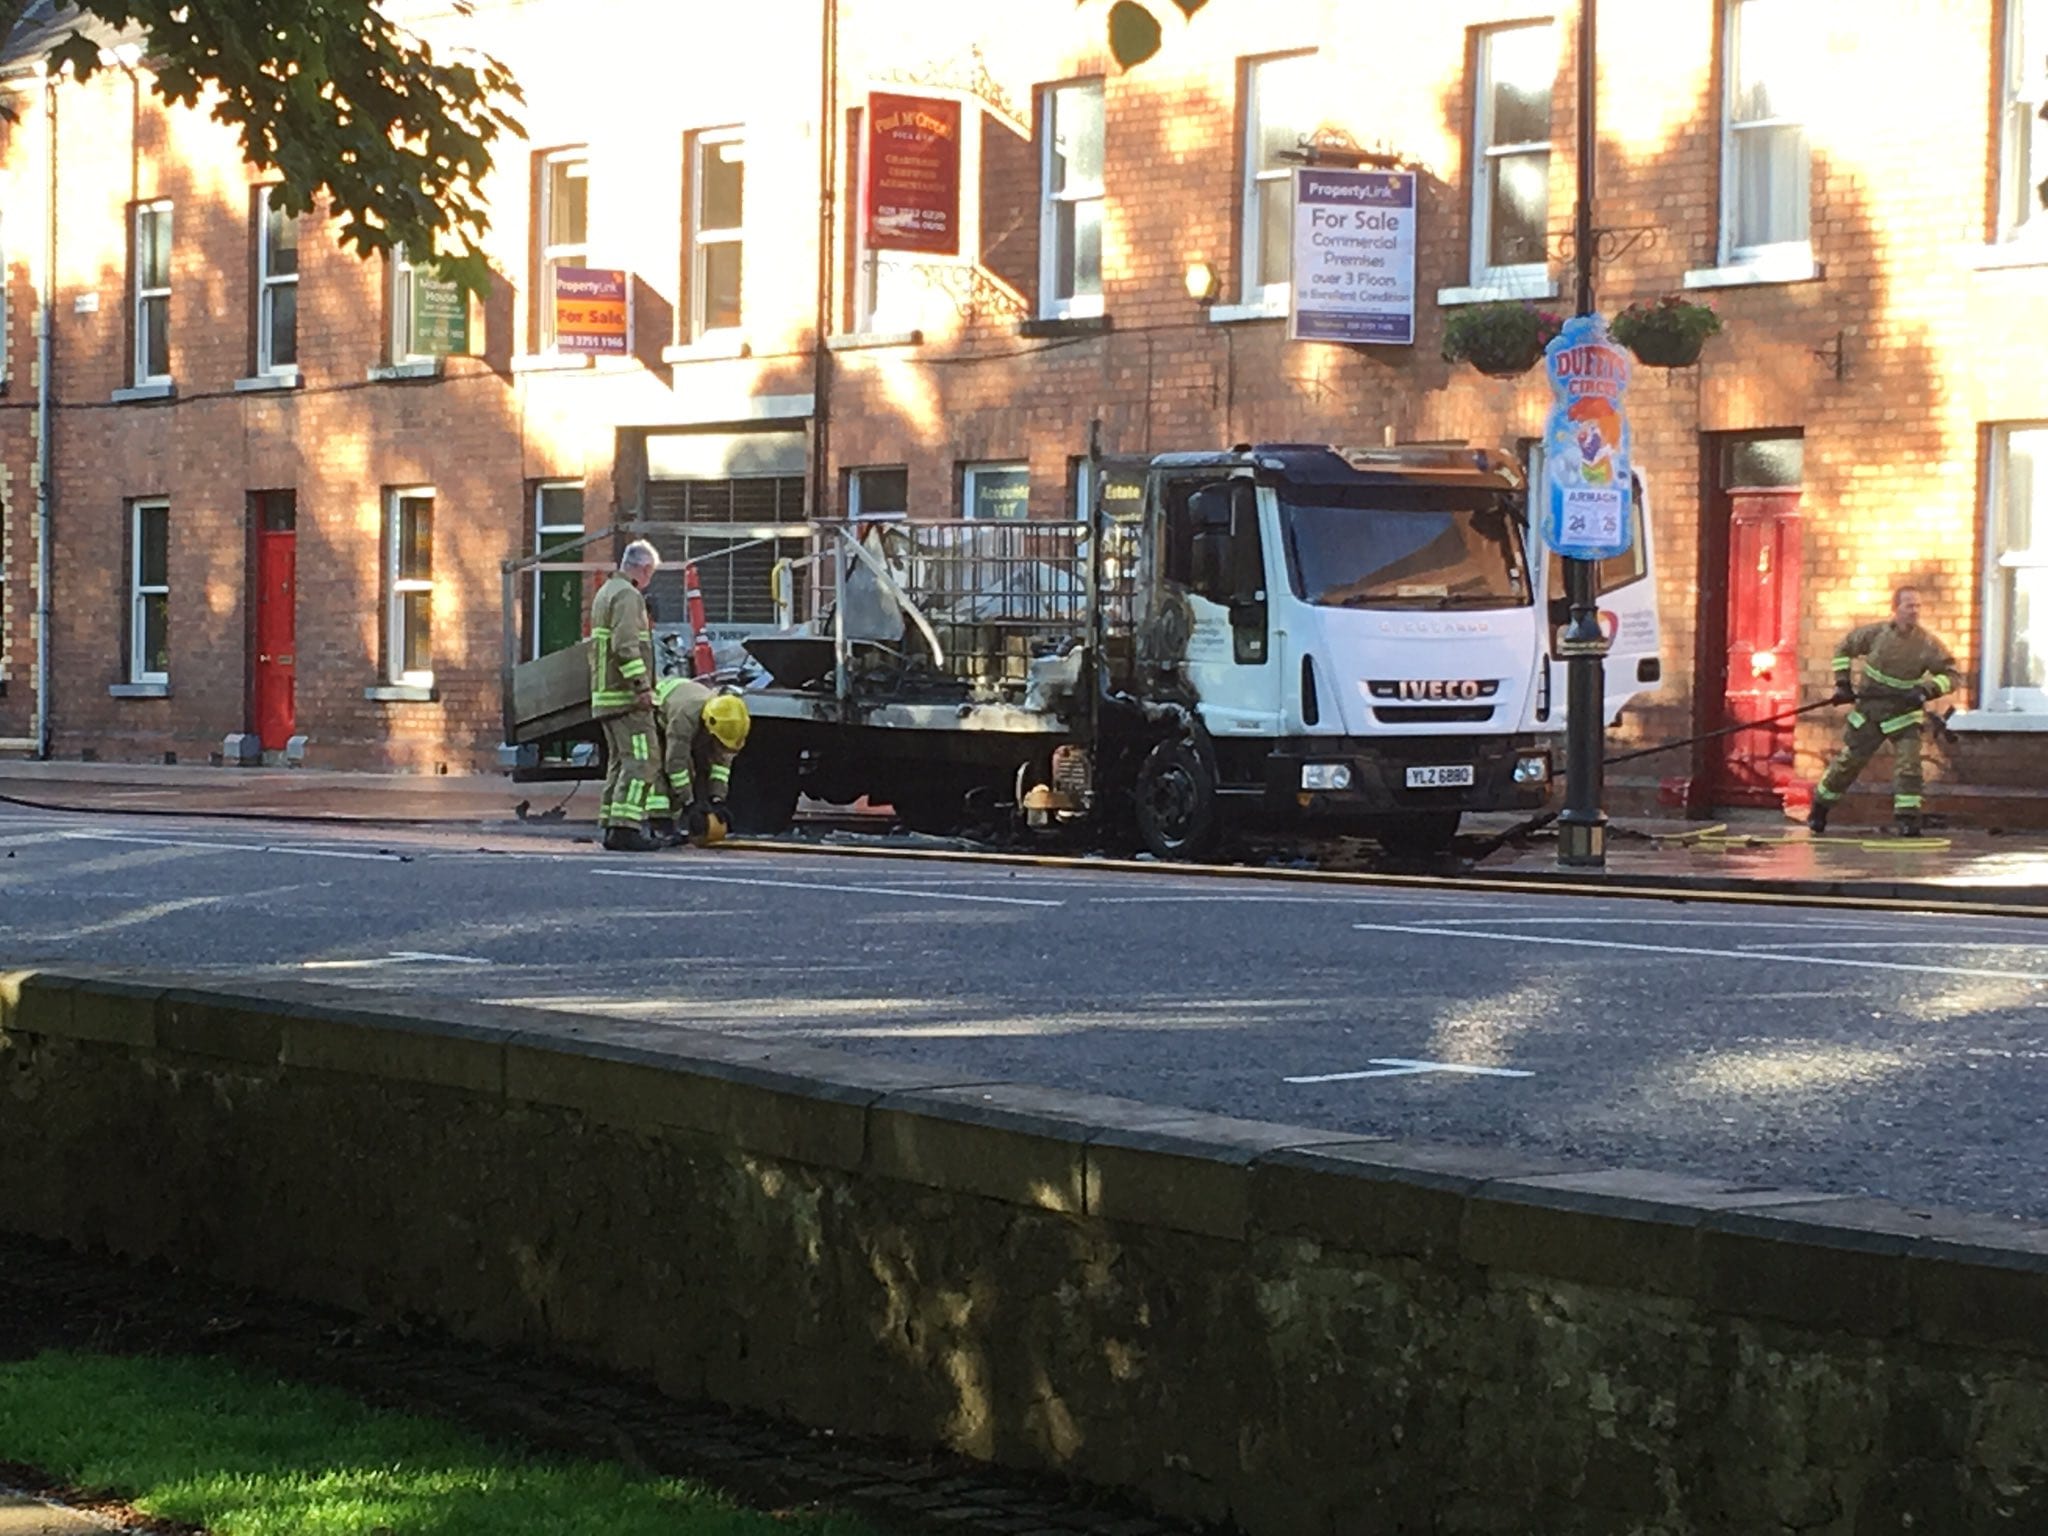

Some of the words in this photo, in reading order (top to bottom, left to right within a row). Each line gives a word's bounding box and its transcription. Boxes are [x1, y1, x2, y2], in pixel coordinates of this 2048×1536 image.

[1309, 182, 1392, 200] PropertyLink
[1312, 208, 1348, 228] For
[1355, 210, 1399, 231] Sale
[1312, 232, 1397, 249] Commercial
[1324, 250, 1385, 268] Premises
[1312, 273, 1341, 284] over
[1345, 271, 1353, 285] 3
[1358, 272, 1397, 287] Floors
[558, 280, 617, 295] PropertyLink
[1310, 288, 1356, 301] Excellent
[1360, 290, 1410, 302] Condition
[425, 291, 458, 304] House
[558, 309, 583, 324] For
[589, 309, 625, 325] Sale
[1569, 380, 1617, 398] CIRCUS
[1104, 483, 1140, 499] Estate
[1568, 491, 1617, 502] ARMAGH
[993, 502, 1017, 517] VAT
[1569, 514, 1586, 531] 24
[1399, 680, 1478, 701] IVECO
[1412, 768, 1436, 784] YLZ
